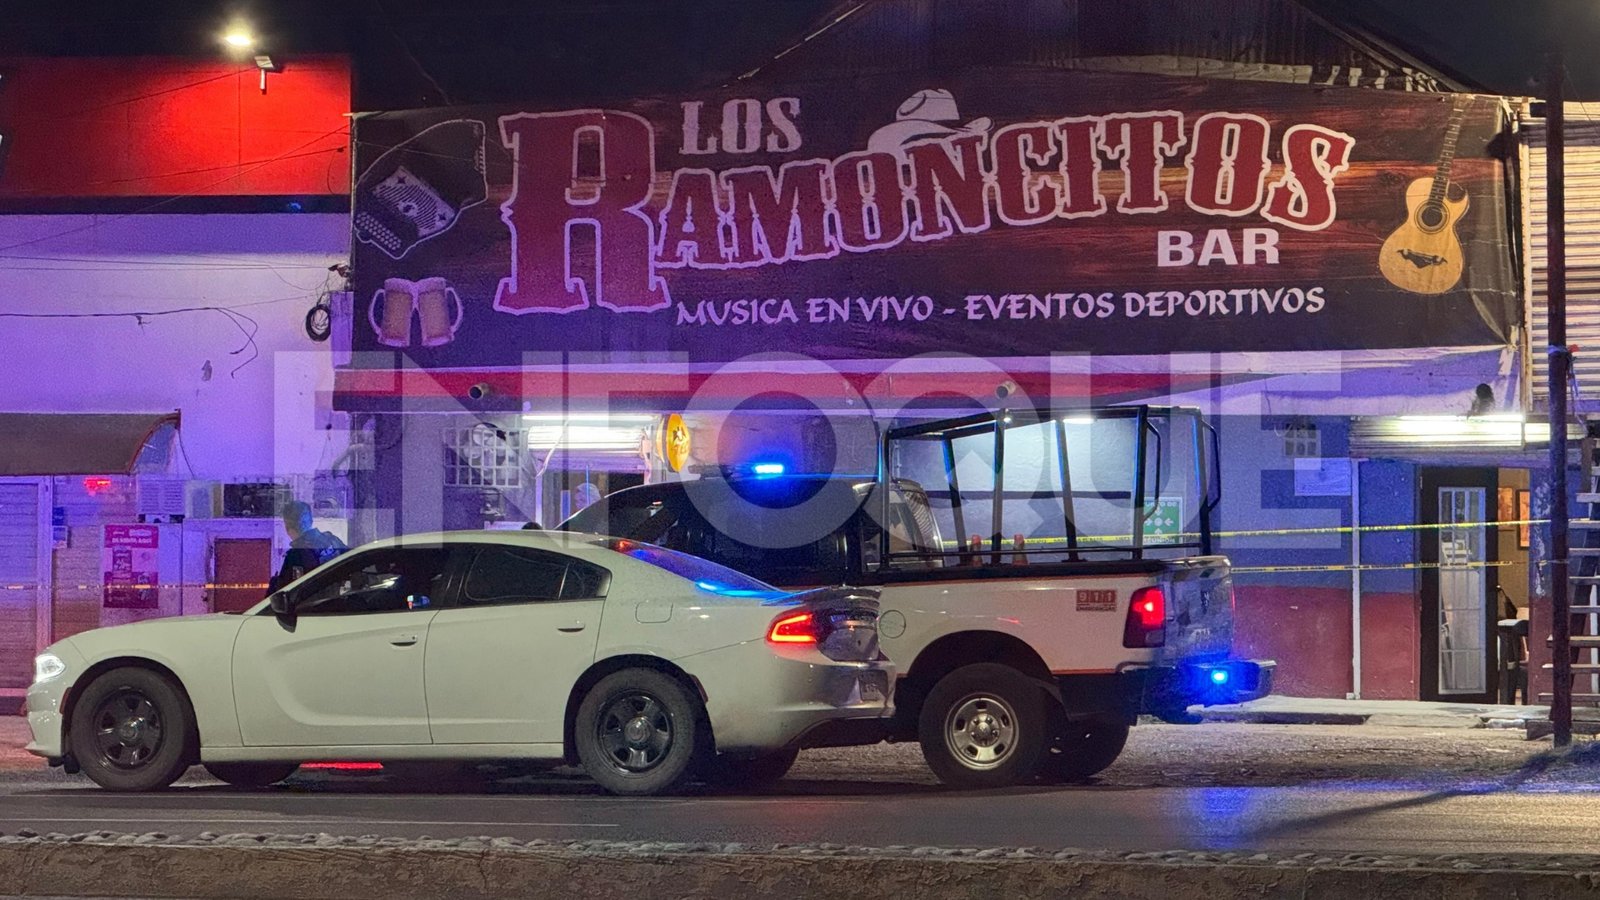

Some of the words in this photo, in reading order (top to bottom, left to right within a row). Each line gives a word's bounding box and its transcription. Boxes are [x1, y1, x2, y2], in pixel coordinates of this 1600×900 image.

[679, 97, 803, 155] LOS
[493, 108, 1356, 315] RAMONCITOS
[1157, 228, 1280, 267] BAR
[676, 298, 799, 326] MUSICA
[806, 296, 850, 323] EN
[856, 295, 934, 322] VIVO
[964, 291, 1115, 320] EVENTOS
[1122, 286, 1326, 318] DEPORTIVOS
[1079, 591, 1113, 602] 911
